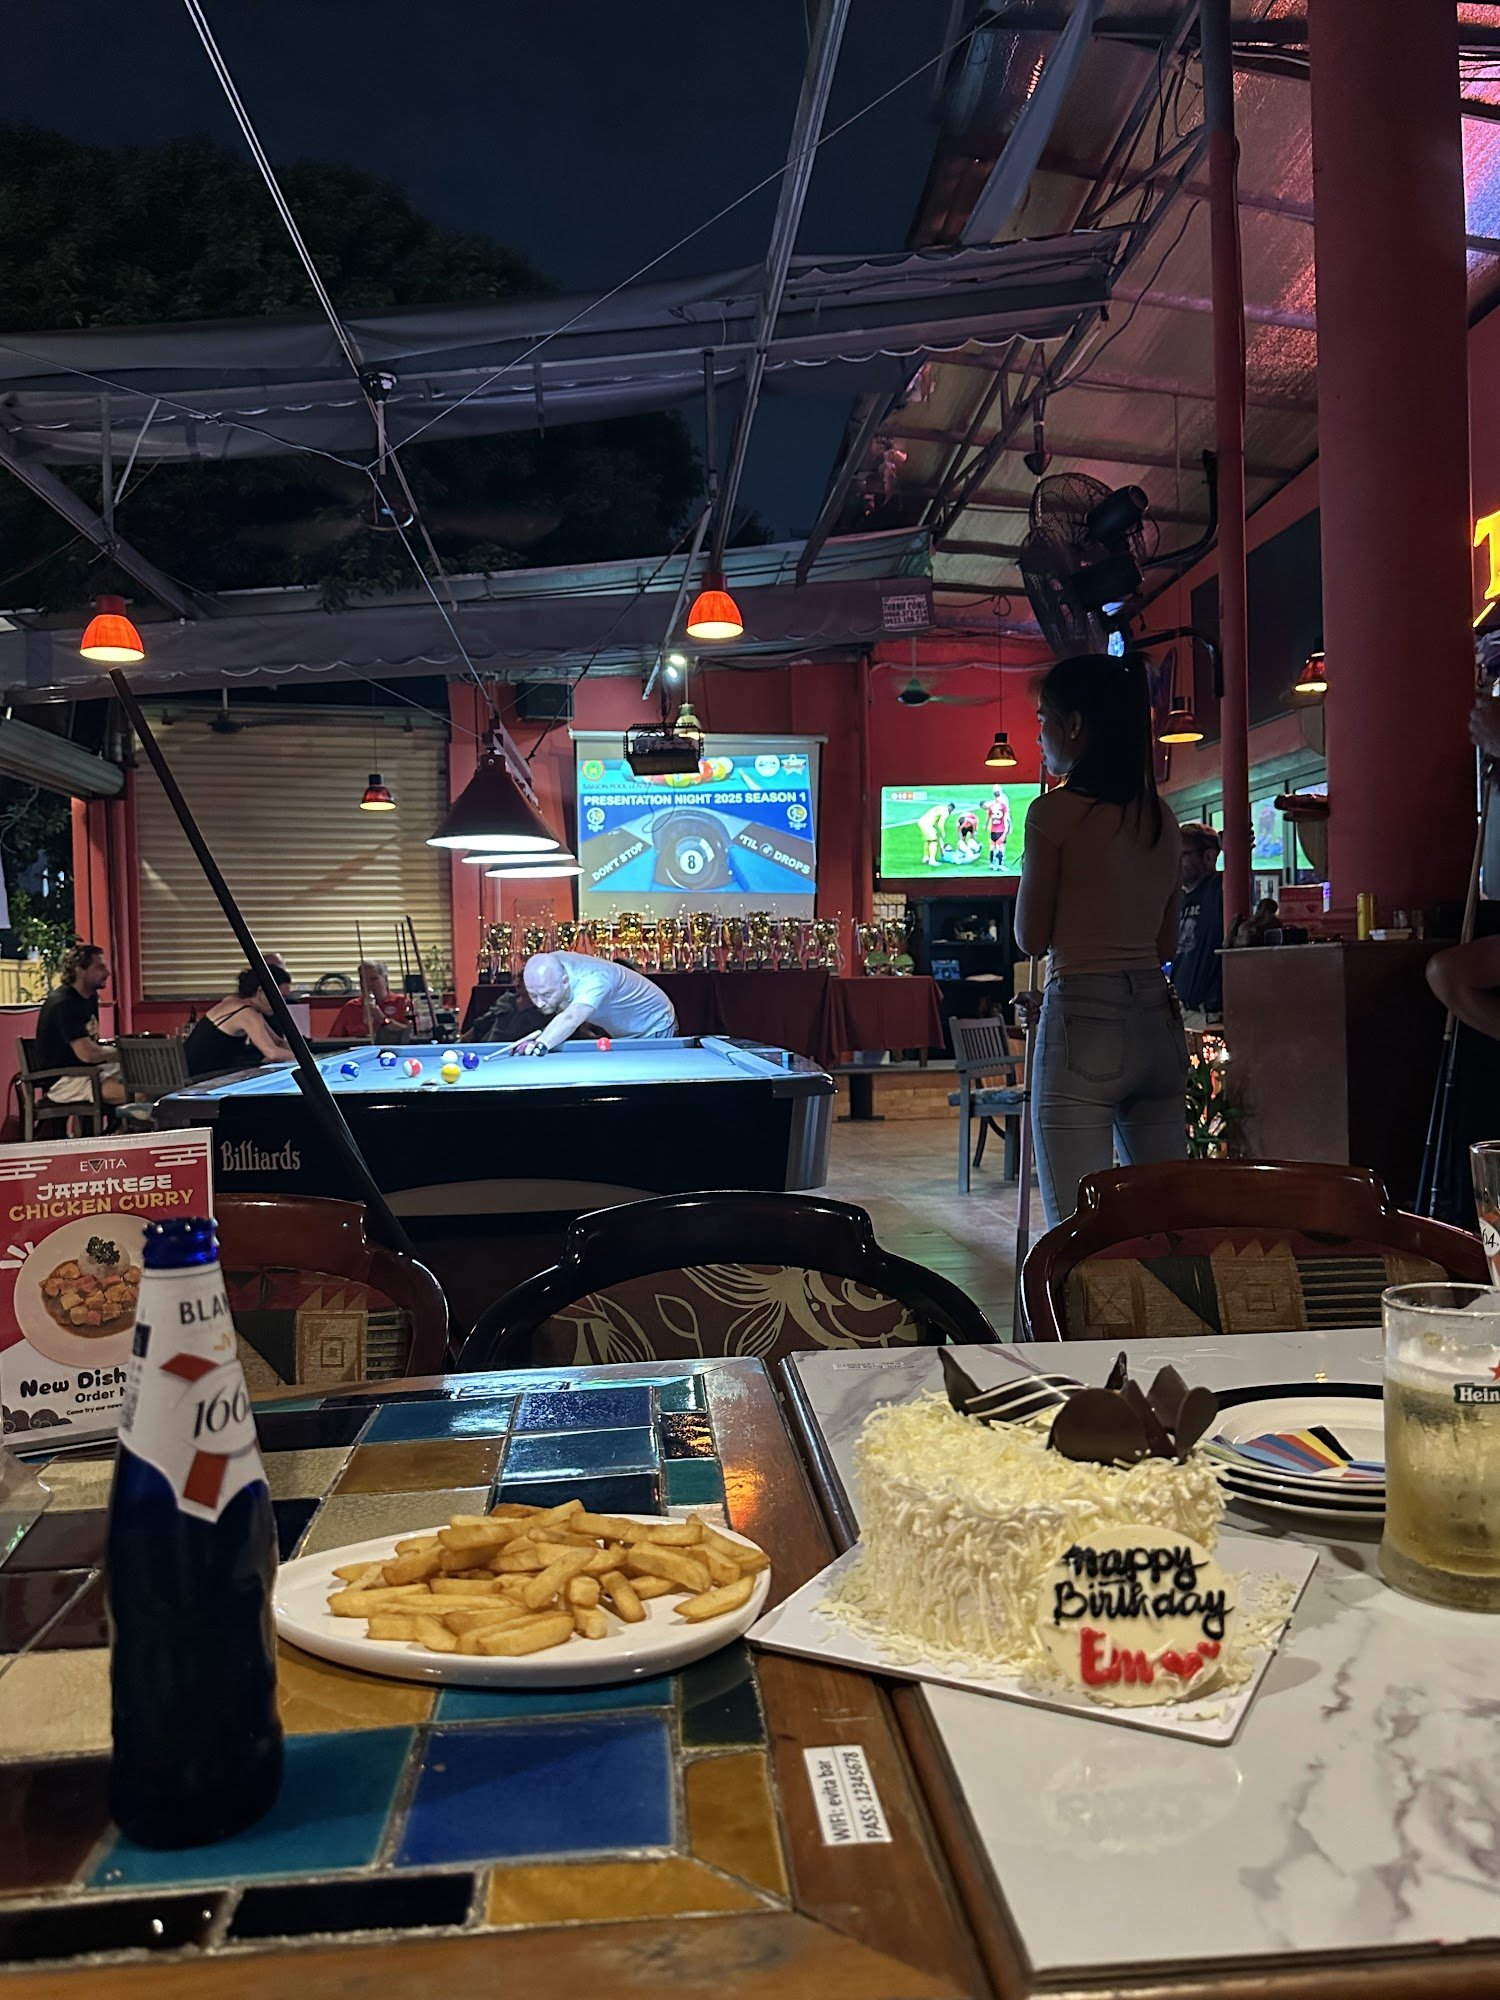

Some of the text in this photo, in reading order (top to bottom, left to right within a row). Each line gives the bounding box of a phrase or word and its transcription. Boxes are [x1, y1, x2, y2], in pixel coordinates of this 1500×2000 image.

[583, 792, 806, 806] PRESENTATION NIGHT 2025 SEASON 1
[620, 842, 643, 862] STOP
[688, 854, 696, 870] 8
[773, 850, 811, 874] DROPS
[80, 1158, 127, 1174] EVITA
[220, 1139, 301, 1171] Billiards
[36, 1174, 172, 1200] JAPANESE
[9, 1189, 193, 1222] CHICKEN CURRY
[20, 1367, 127, 1398] New Dish
[75, 1390, 115, 1403] Order
[1053, 1580, 1235, 1640] Birthday
[1080, 1626, 1154, 1687] Em
[818, 1760, 834, 1778] bar
[823, 1779, 842, 1806] evita
[843, 1752, 884, 1839] PASS: 12345678
